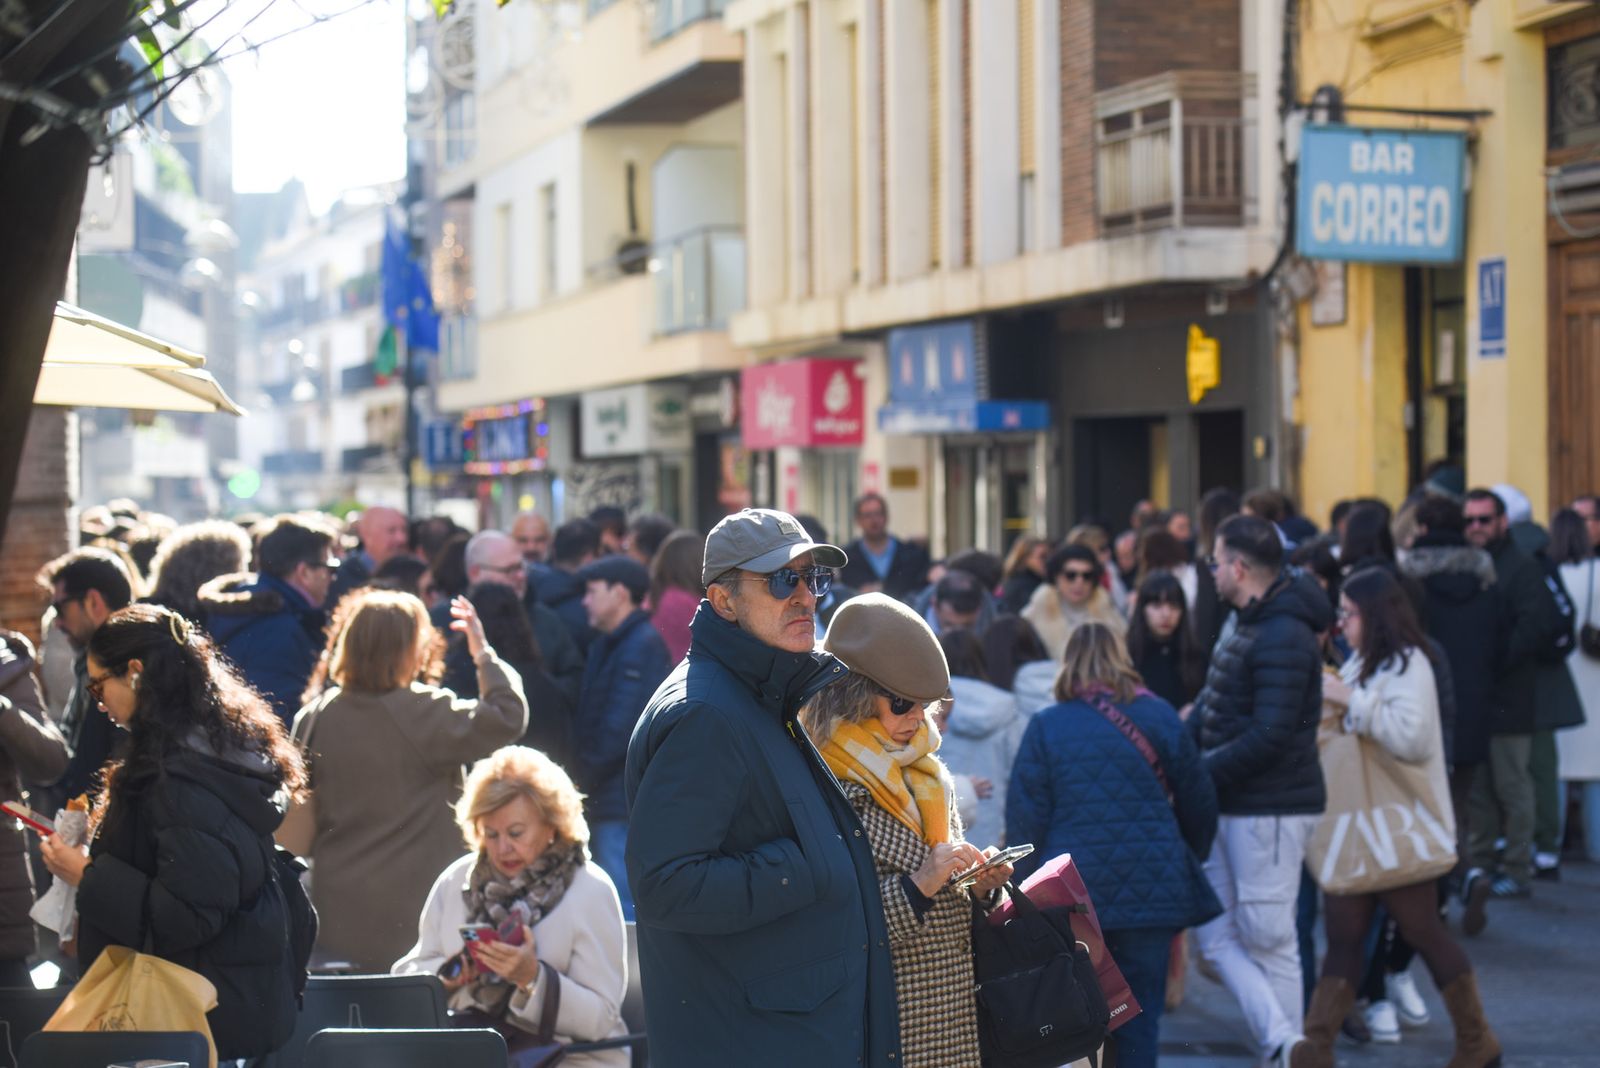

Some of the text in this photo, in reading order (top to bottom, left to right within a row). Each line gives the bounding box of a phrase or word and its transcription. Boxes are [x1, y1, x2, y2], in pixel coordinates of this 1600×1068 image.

[1352, 143, 1414, 174] BAR
[1313, 183, 1450, 246] CORREO
[1319, 799, 1456, 885] ZARA
